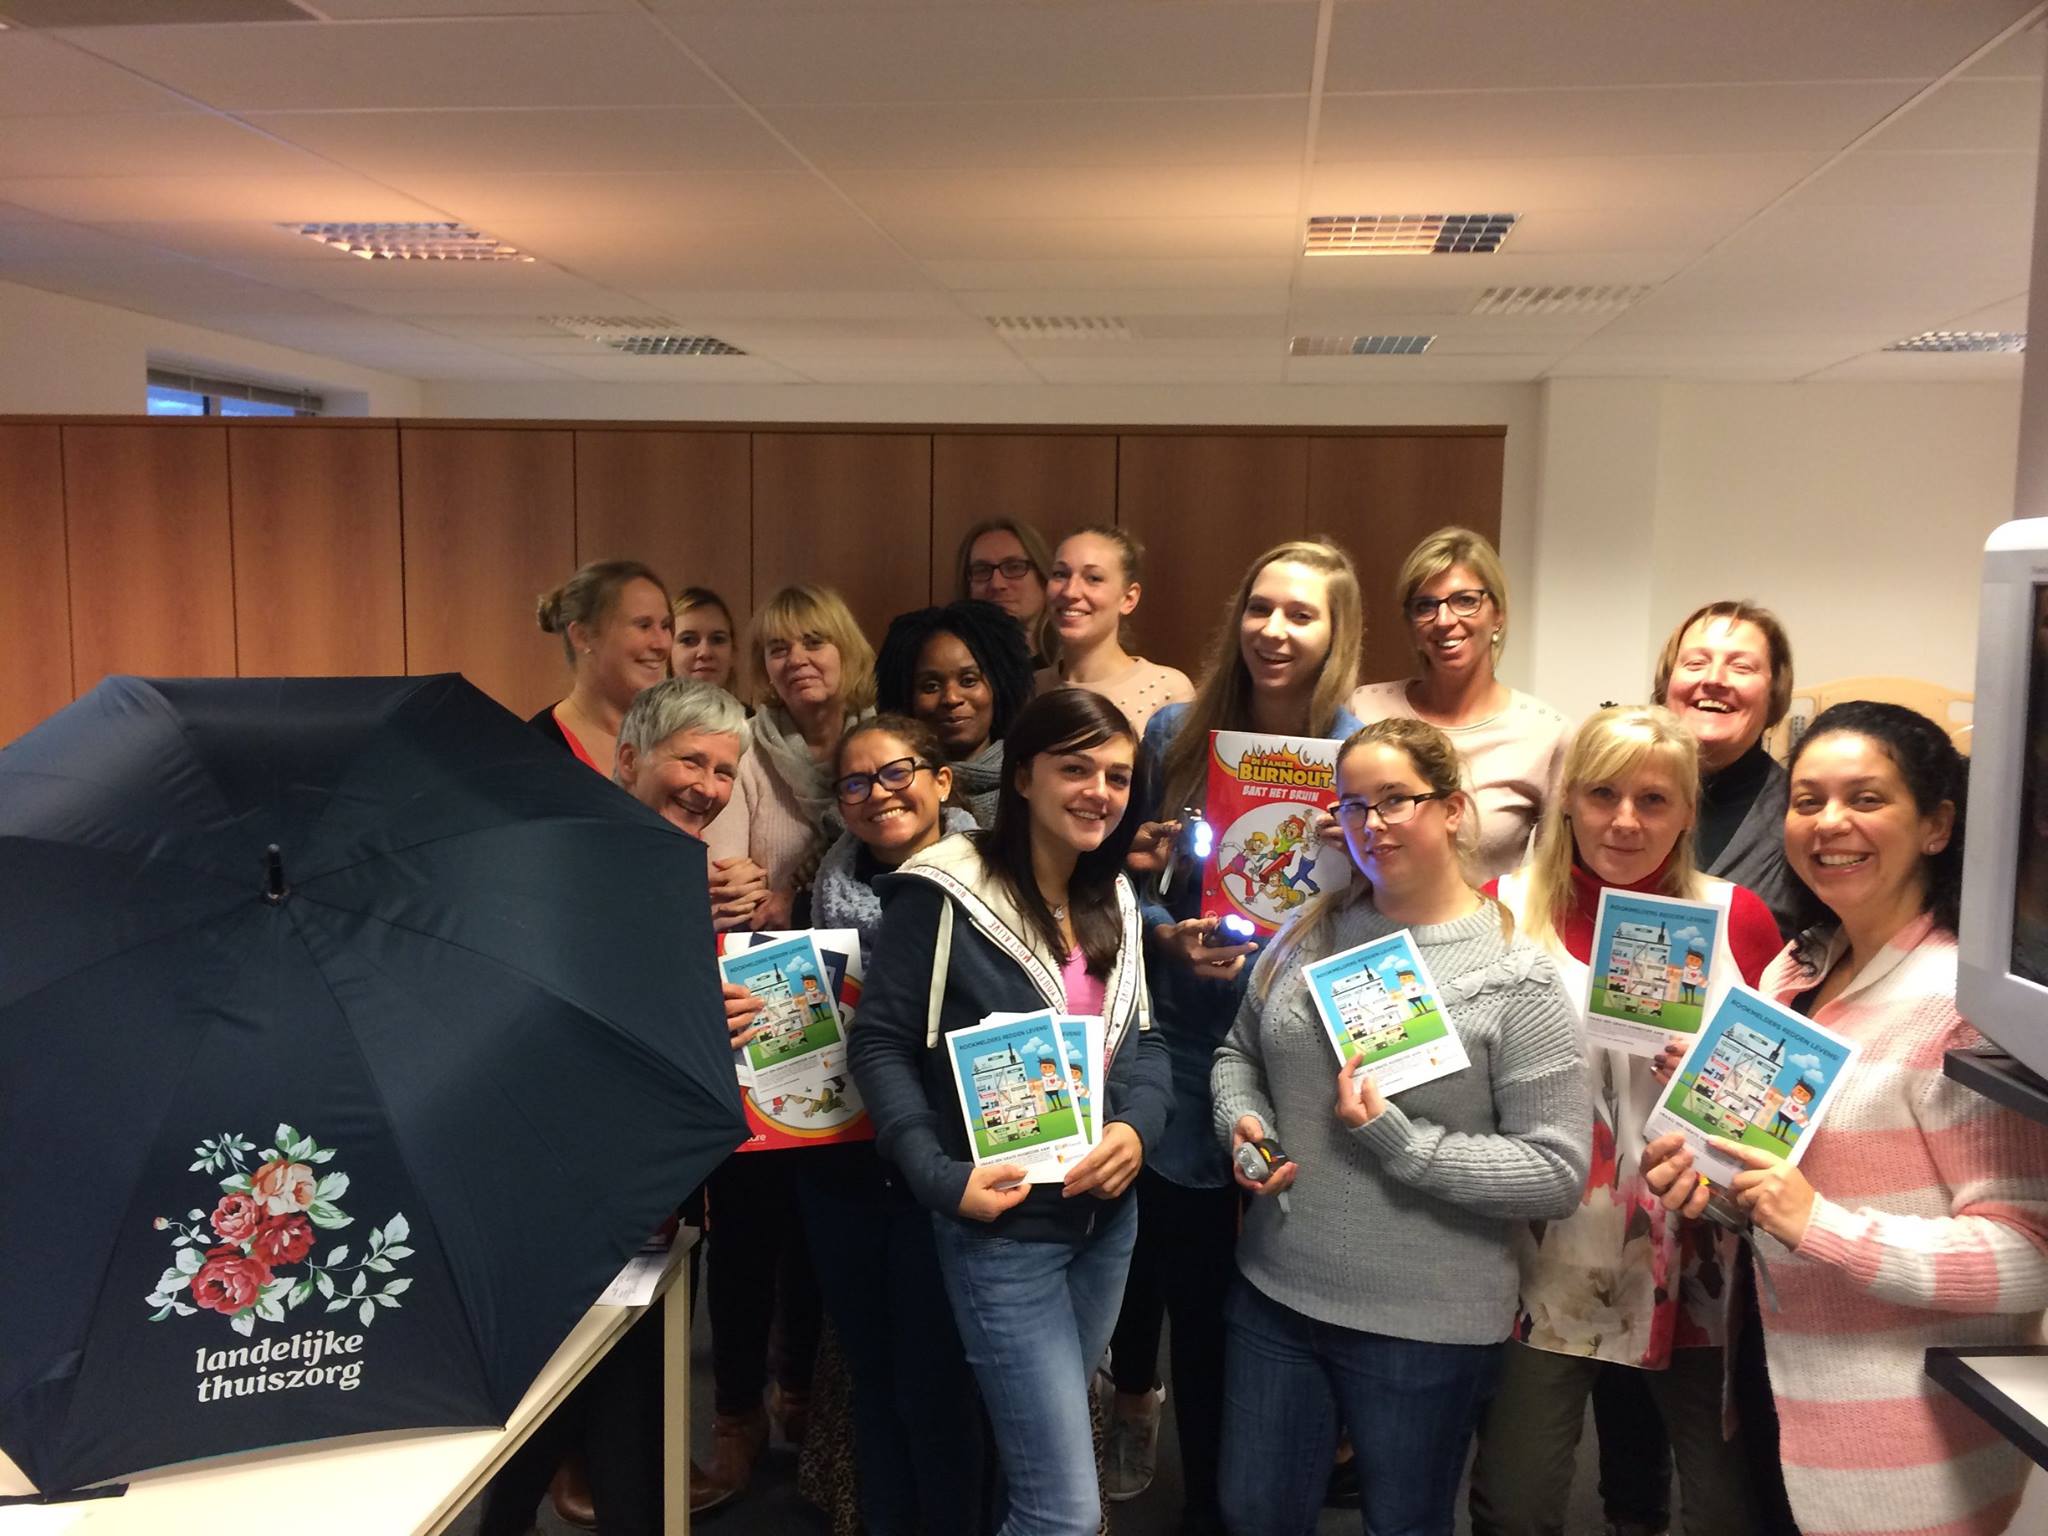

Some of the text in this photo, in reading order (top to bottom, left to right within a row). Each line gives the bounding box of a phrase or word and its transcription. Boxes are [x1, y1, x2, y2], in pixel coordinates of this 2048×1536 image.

[1238, 761, 1334, 788] BURNOUT
[1269, 788, 1288, 799] HET
[195, 1329, 364, 1374] landelijke
[196, 1360, 364, 1403] thuiszorg
